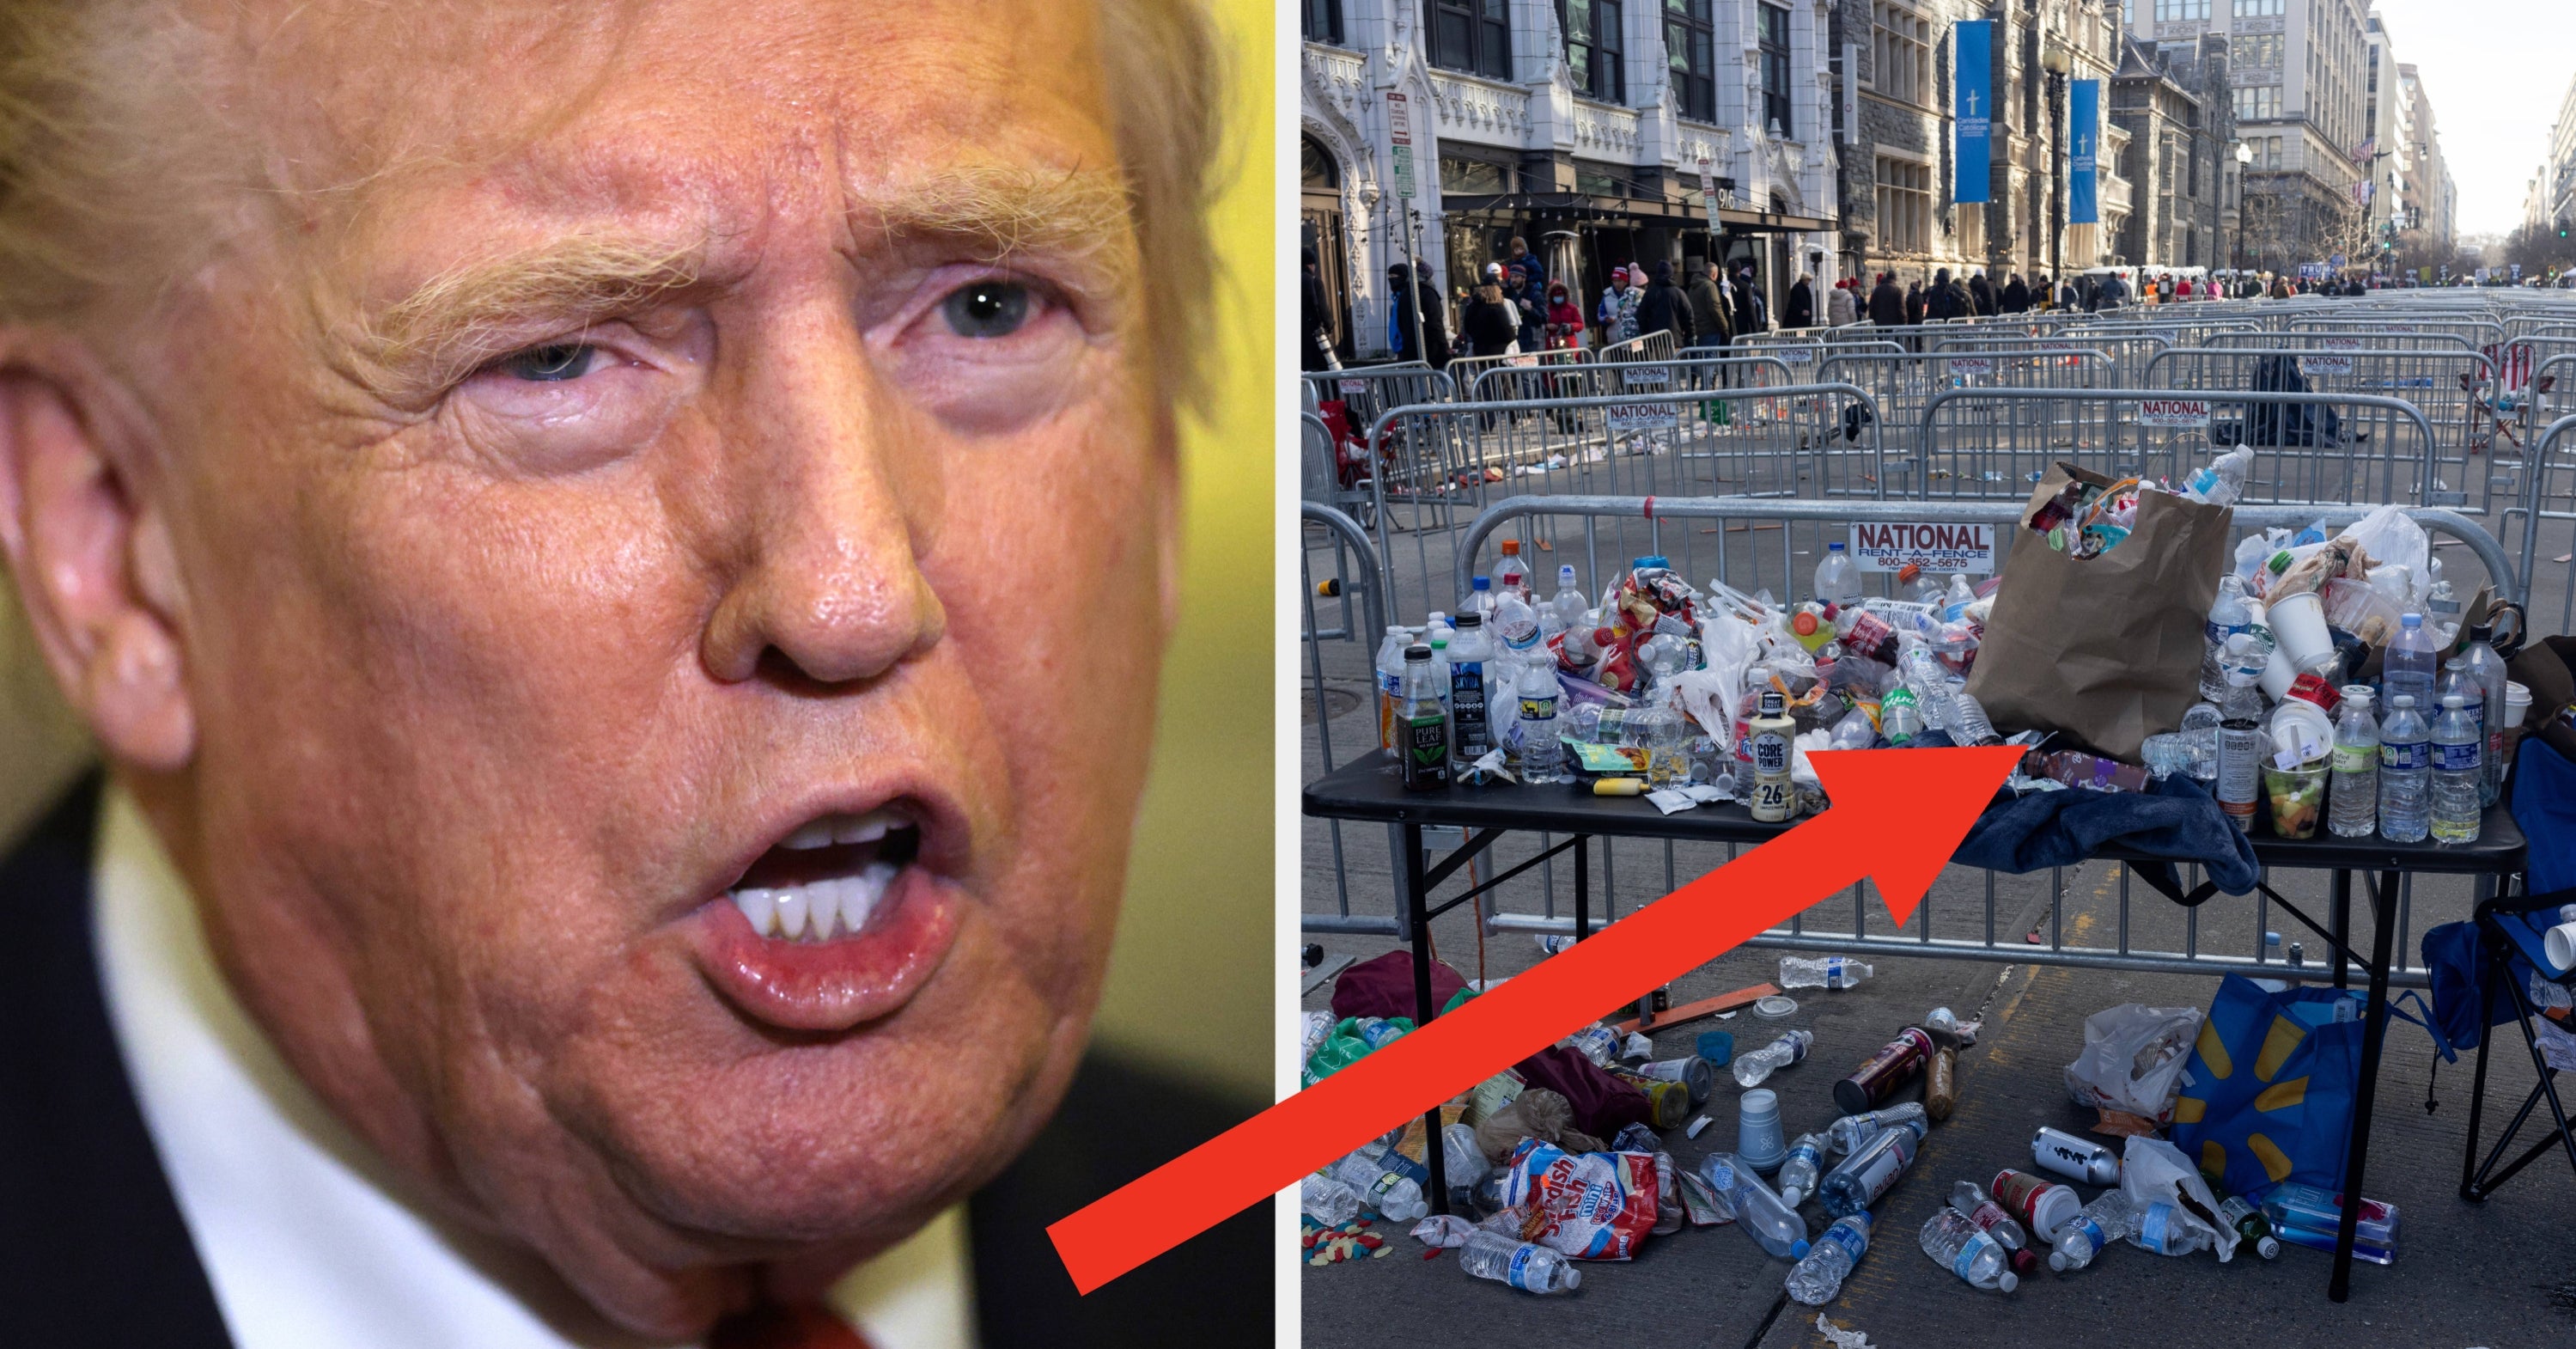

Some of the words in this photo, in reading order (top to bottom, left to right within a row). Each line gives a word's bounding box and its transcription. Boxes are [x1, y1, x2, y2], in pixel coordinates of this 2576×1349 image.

[1719, 188, 1735, 209] 916
[1952, 359, 1990, 368] NATIONAL
[2305, 357, 2351, 366] NATIONAL
[1626, 367, 1667, 376] NATIONAL
[1610, 404, 1676, 418] NATIONAL
[2143, 400, 2208, 415] NATIONAL
[1858, 524, 1990, 551] NATIONAL
[1858, 548, 1989, 559] RENT-A-FENCE
[1878, 557, 1969, 568] 800-352-5675
[1455, 677, 1479, 689] SKYRA
[1416, 725, 1442, 736] PURE
[1416, 734, 1442, 745] LEAF
[1757, 743, 1783, 757] CORE
[1758, 757, 1783, 767] POWER
[1873, 1169, 1900, 1198] evian
[1580, 1184, 1604, 1218] mini
[1591, 1206, 1605, 1224] Red
[1599, 1181, 1612, 1208] White
[1603, 1212, 1613, 1223] &
[1609, 1191, 1621, 1214] Blue
